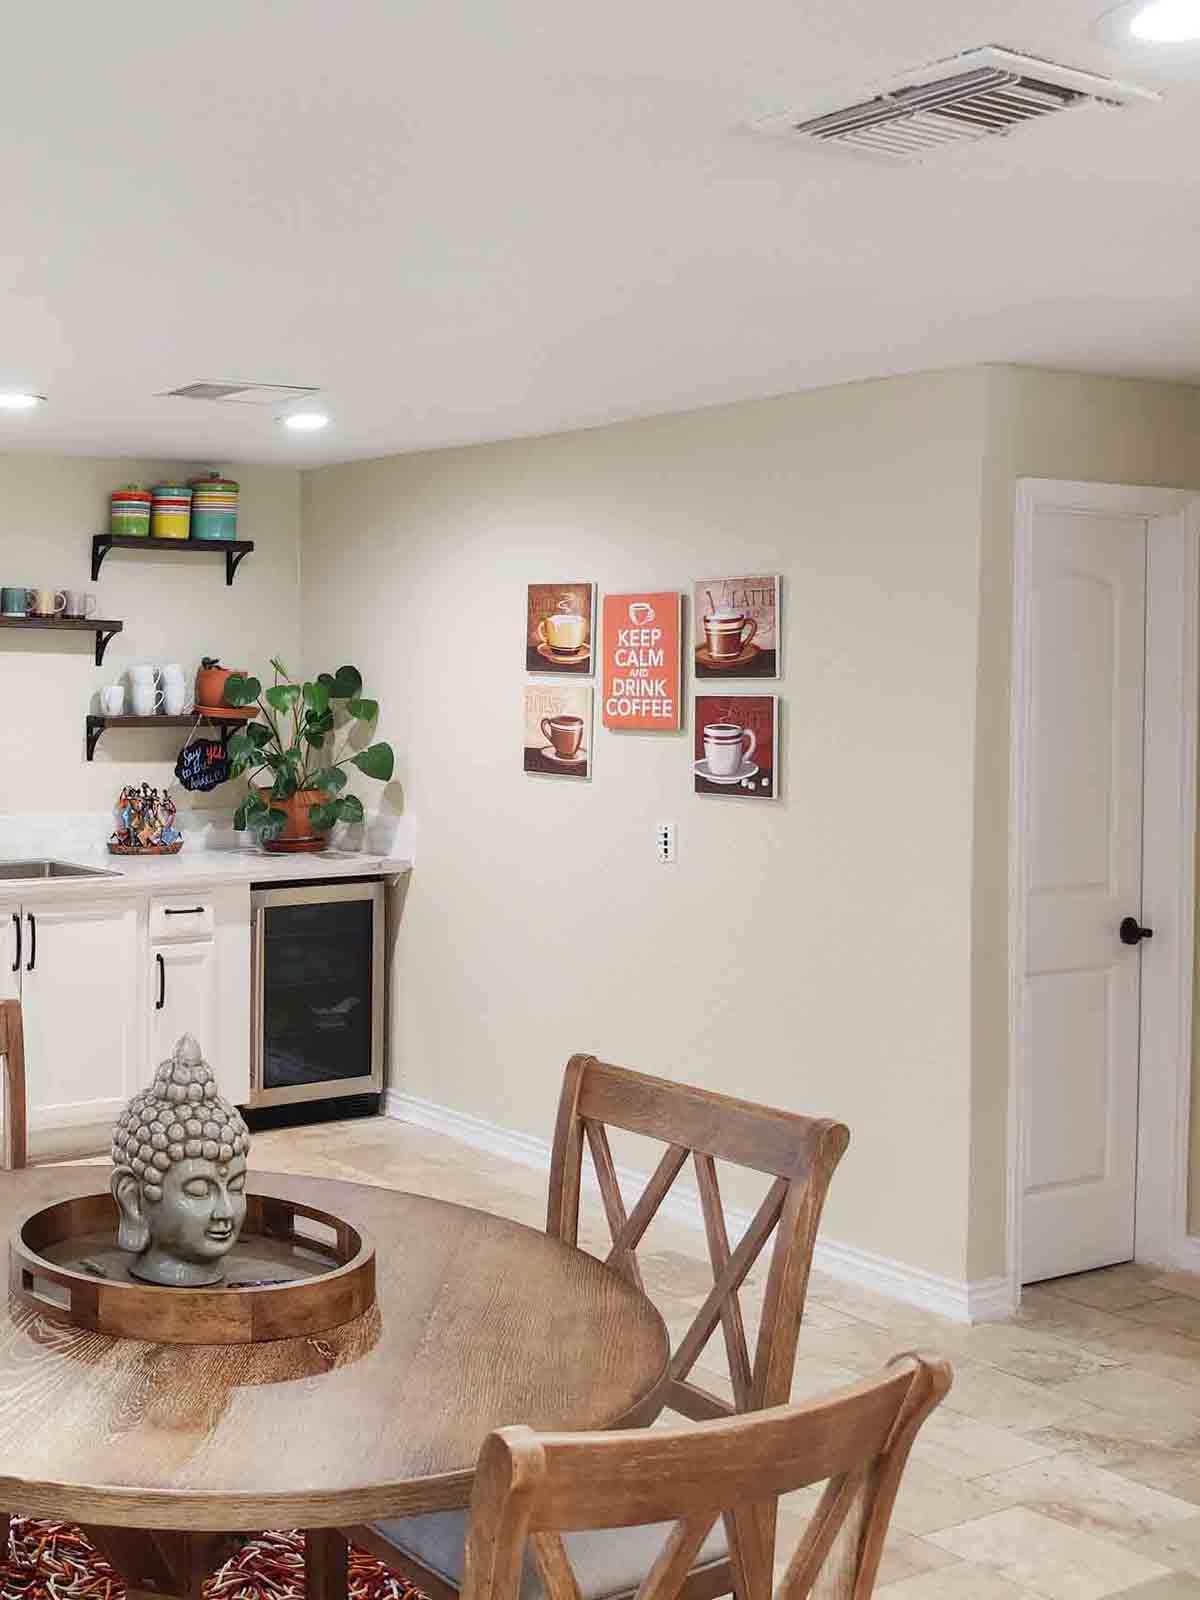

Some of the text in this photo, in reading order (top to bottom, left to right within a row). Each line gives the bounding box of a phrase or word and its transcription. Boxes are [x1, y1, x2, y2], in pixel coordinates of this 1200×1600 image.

[732, 590, 775, 608] LATTE
[617, 629, 662, 647] KEEP
[615, 649, 665, 667] CALM
[630, 668, 649, 678] AND
[612, 678, 667, 697] DRINK
[606, 699, 673, 718] COFFEE
[183, 747, 201, 769] Say
